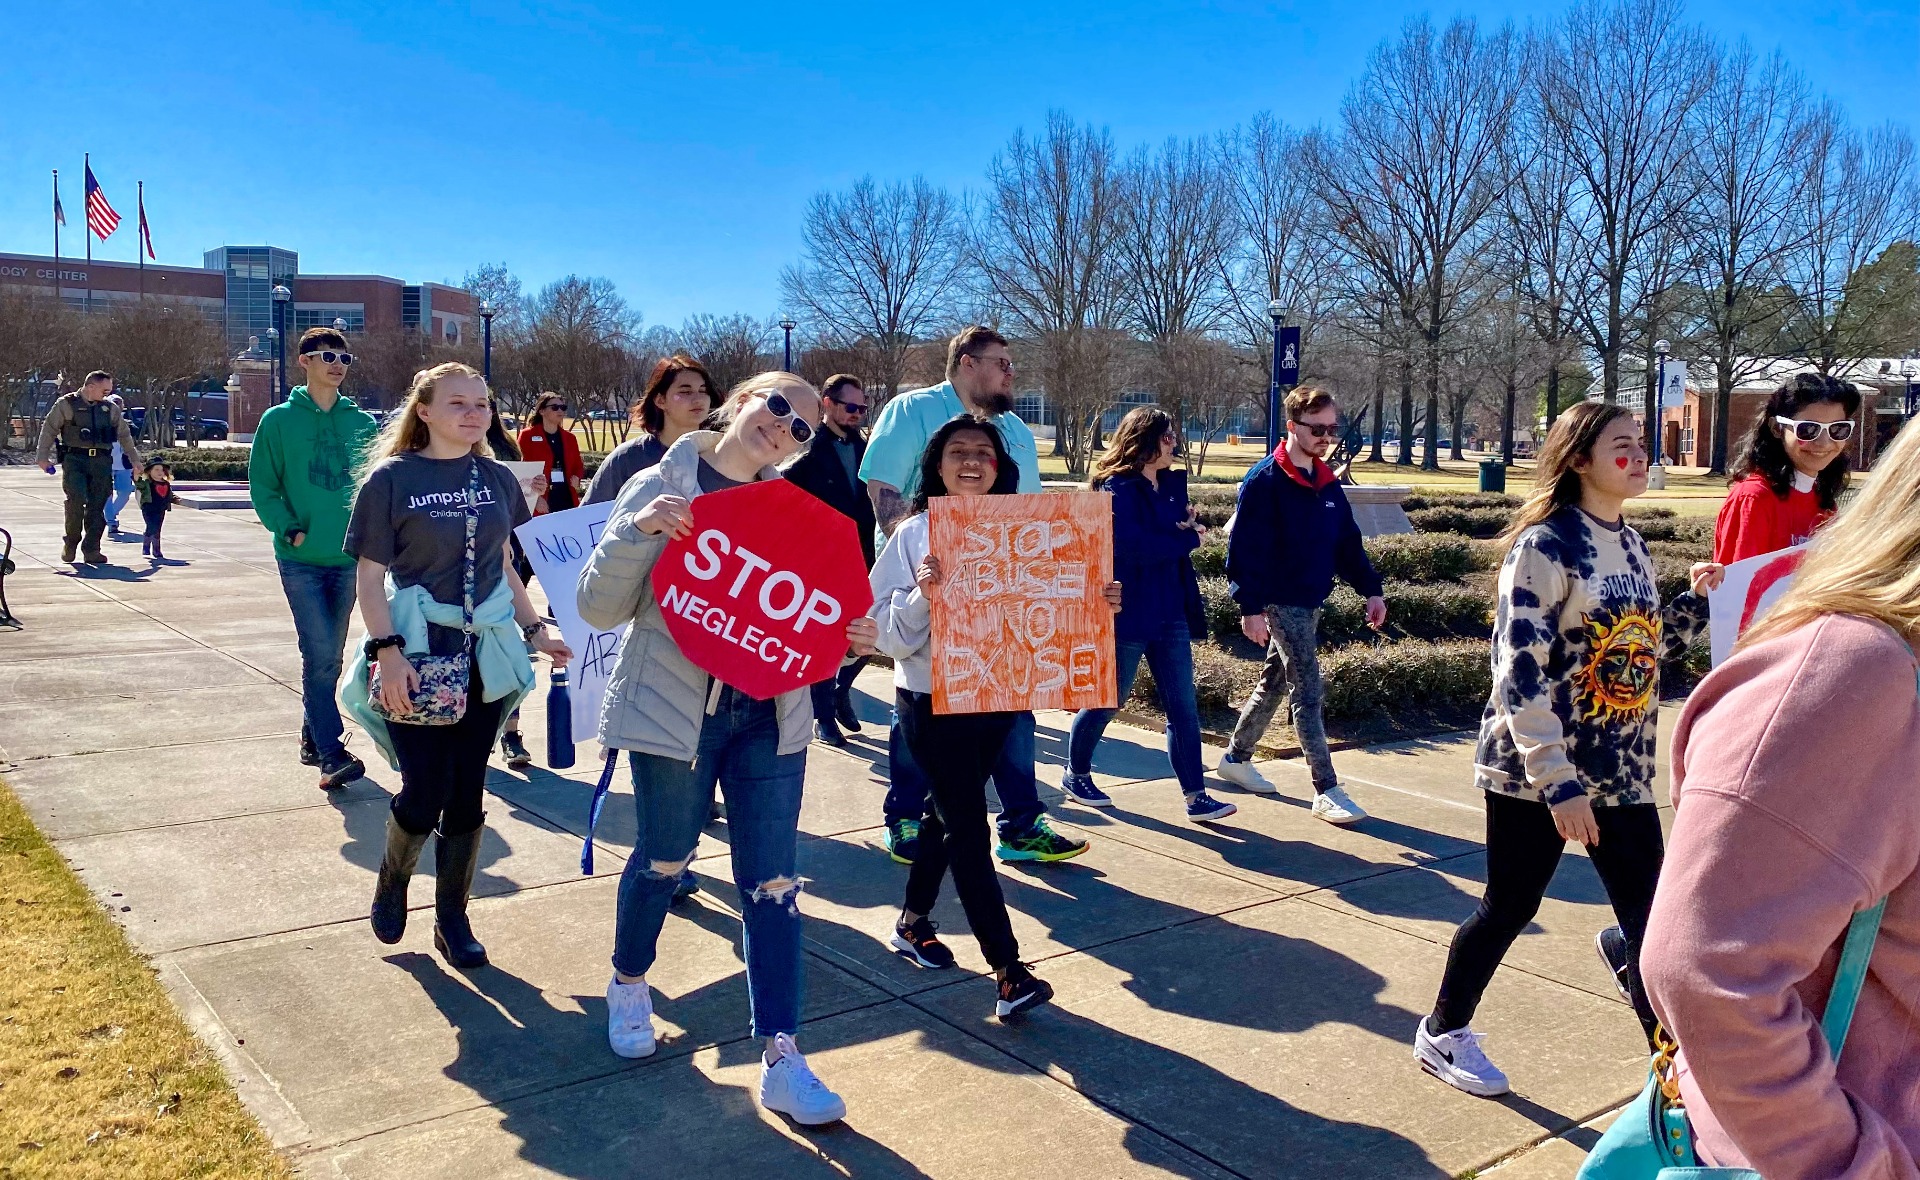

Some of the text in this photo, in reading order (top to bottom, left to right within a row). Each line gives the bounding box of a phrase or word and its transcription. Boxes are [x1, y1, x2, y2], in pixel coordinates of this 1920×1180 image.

[0, 266, 88, 281] OGY CENTER
[408, 485, 492, 509] Jumpstrt
[430, 510, 463, 518] Children
[535, 533, 583, 563] NO
[959, 519, 1072, 561] STOP
[684, 529, 842, 634] STOP
[943, 560, 1087, 601] ABUSE
[660, 584, 812, 679] NEGLECT!
[997, 600, 1056, 649] NO
[579, 633, 622, 690] AB
